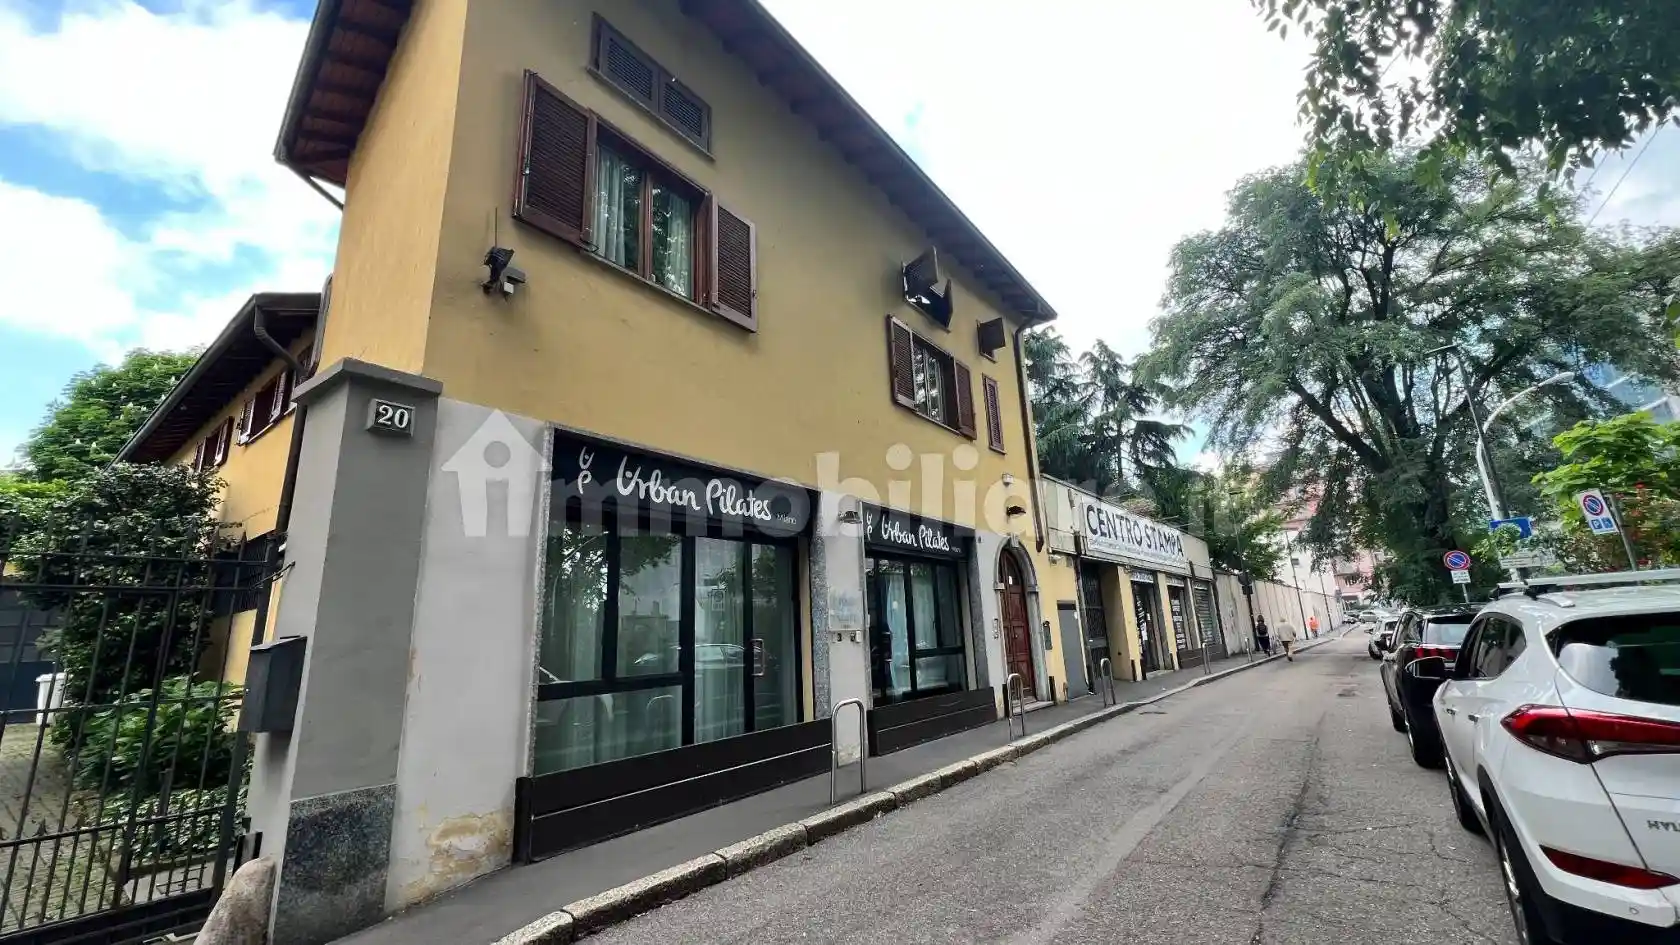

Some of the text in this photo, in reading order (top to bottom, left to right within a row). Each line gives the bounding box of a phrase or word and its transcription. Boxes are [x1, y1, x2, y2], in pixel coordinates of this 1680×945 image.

[378, 405, 408, 428] 20
[616, 455, 700, 510] Urban
[705, 478, 771, 520] Pilates
[881, 514, 949, 551] Urban Pilates
[1086, 504, 1143, 547] CENTRO
[1144, 523, 1184, 557] STAMPA
